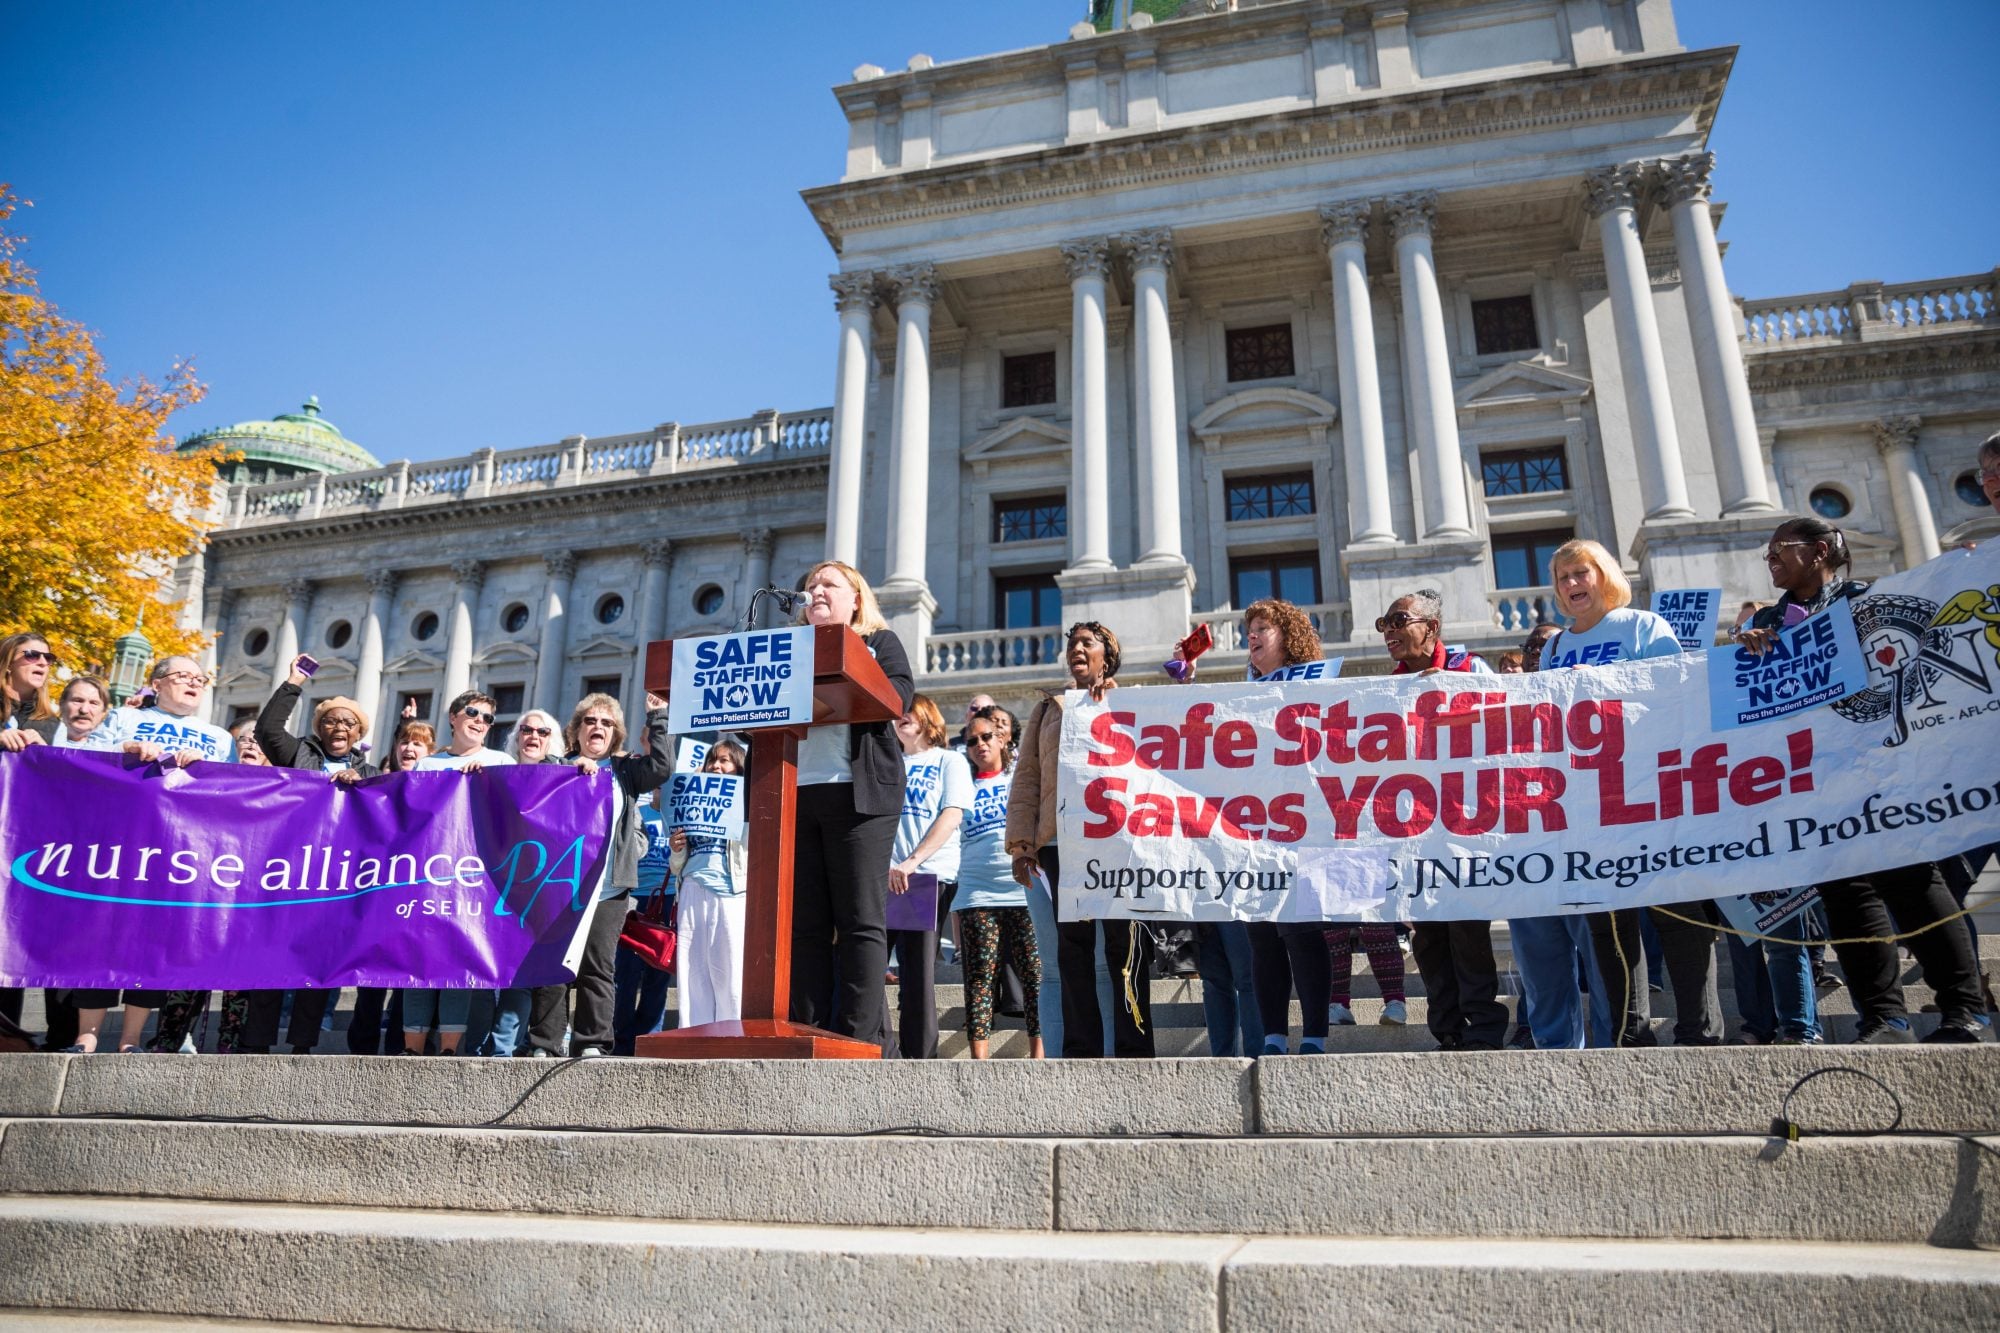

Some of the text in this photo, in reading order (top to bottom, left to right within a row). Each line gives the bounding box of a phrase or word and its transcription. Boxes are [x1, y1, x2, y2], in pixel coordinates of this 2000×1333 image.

[1658, 592, 1709, 611] SAFE
[1857, 610, 1873, 623] OF
[1670, 622, 1699, 637] OW
[1734, 612, 1835, 672] SAFE
[695, 632, 793, 670] SAFE
[693, 663, 792, 688] STAFFING
[1735, 642, 1839, 688] STAFFING
[702, 681, 782, 711] NOW
[1749, 662, 1831, 708] NOW
[1740, 684, 1843, 722] Pass the Patient Safety Act!
[693, 709, 788, 725] Pass the Patient Safety Act!
[1910, 713, 1945, 731] IUOE
[136, 722, 217, 744] SAFE
[1087, 690, 1625, 770] Safe Staffing
[133, 734, 216, 756] STAFFING
[907, 764, 941, 780] FE
[671, 775, 738, 798] SAFE
[1083, 728, 1815, 844] Saves YOUR Life!
[669, 795, 733, 809] STAFFING
[673, 806, 724, 824] NOW
[1408, 852, 1554, 899] JNESO
[1564, 820, 1774, 888] Registered
[36, 834, 586, 928] nurse alliance PA
[1084, 858, 1293, 900] Support your
[395, 899, 482, 918] of SEIU
[1758, 915, 1773, 929] Pass
[1772, 910, 1782, 920] the
[1782, 897, 1804, 914] Patient
